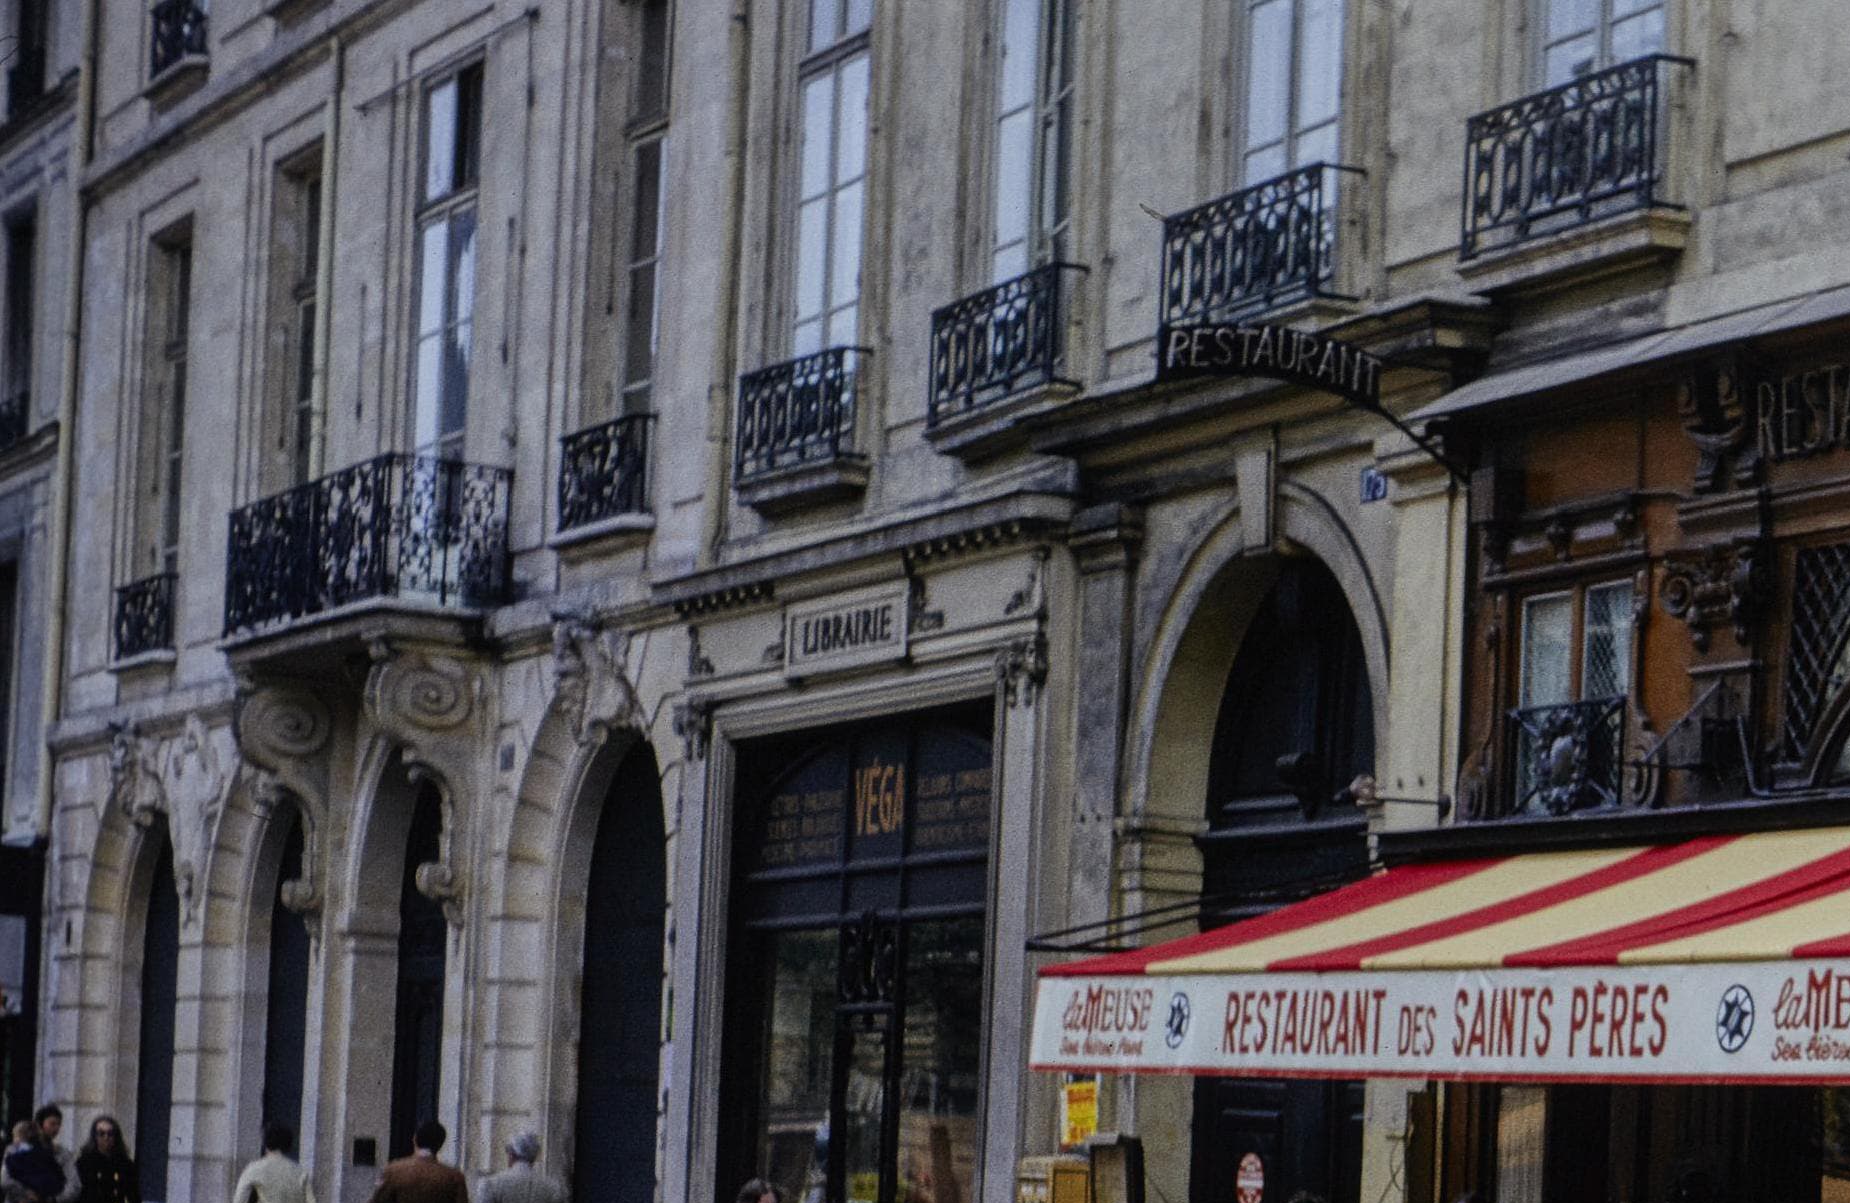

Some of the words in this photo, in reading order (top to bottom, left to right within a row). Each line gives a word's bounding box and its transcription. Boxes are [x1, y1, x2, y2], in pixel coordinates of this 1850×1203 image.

[1166, 324, 1382, 397] RESTAURANT
[802, 604, 892, 655] LIBRAIRIE
[1222, 988, 1387, 1055] RESTAURANT
[1398, 1004, 1437, 1056] DES
[1452, 985, 1554, 1057] SAINTS
